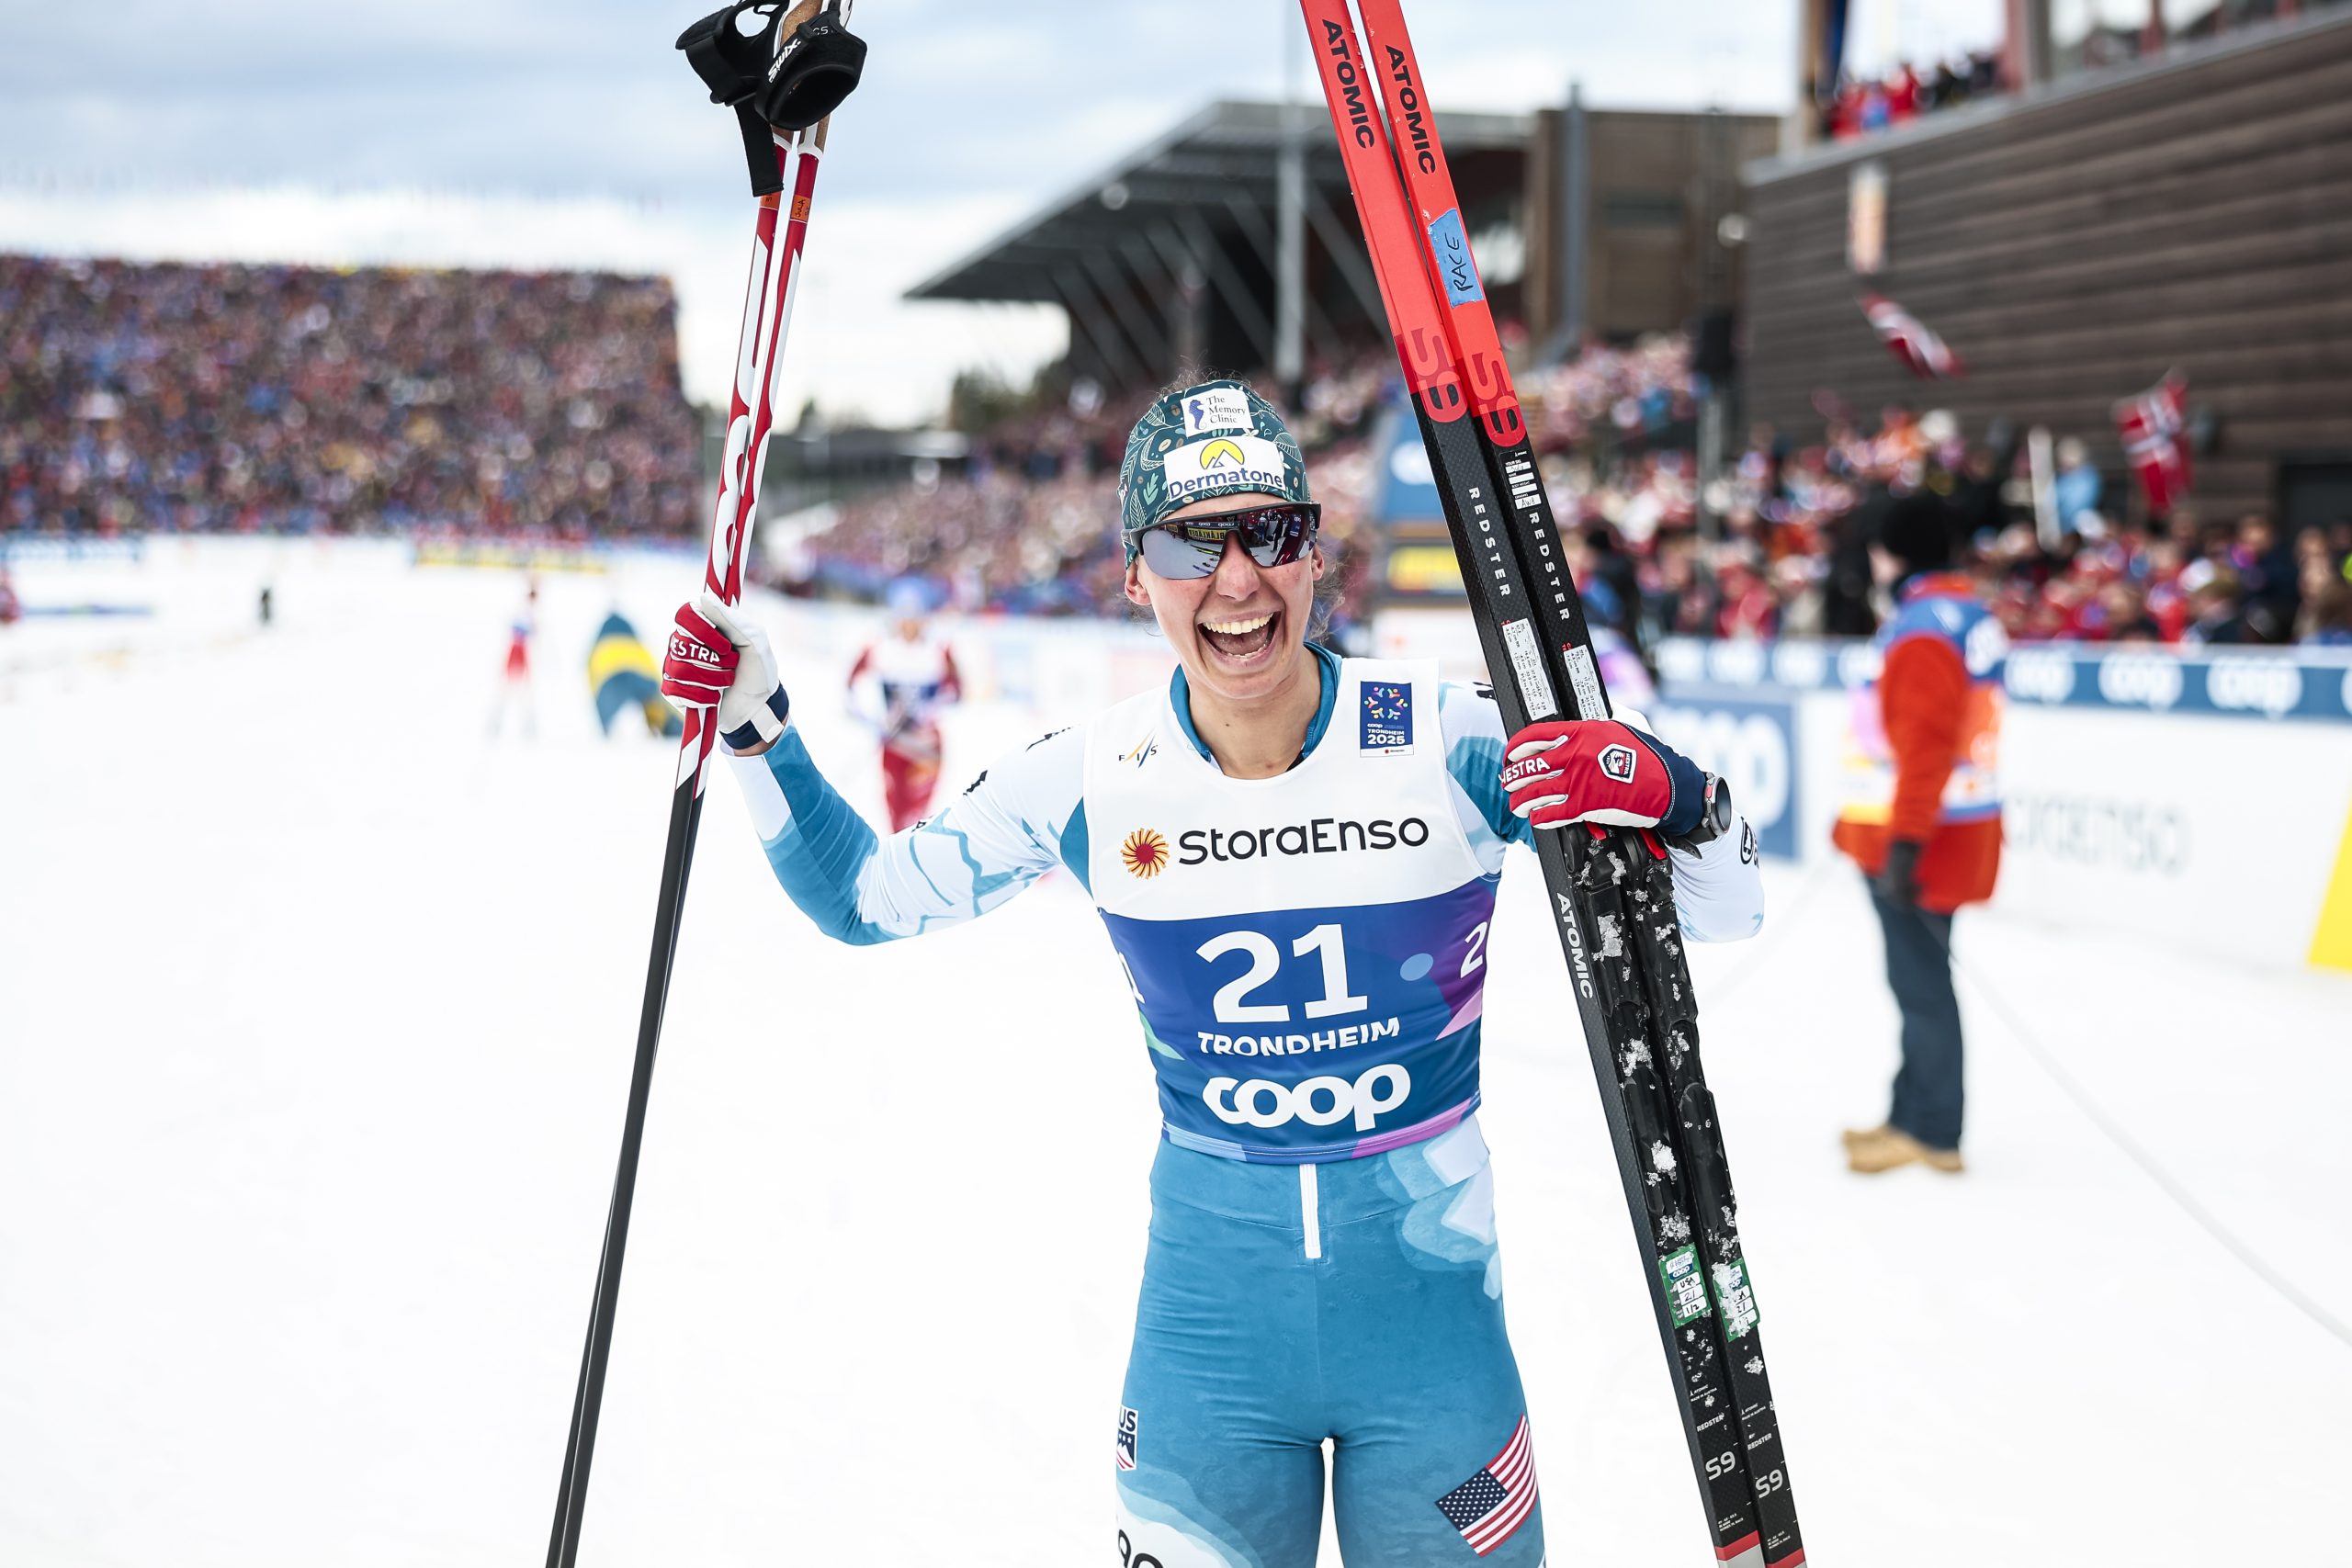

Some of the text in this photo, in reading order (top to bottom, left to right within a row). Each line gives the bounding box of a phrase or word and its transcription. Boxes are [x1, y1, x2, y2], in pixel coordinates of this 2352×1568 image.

[1322, 18, 1375, 149] ATOMIC
[1385, 44, 1436, 175] ATOMIC
[1444, 232, 1474, 292] RACE
[1206, 395, 1225, 405] The
[1208, 405, 1246, 417] Memory
[1210, 414, 1238, 424] Clinic
[1169, 468, 1283, 500] Dermatone
[1469, 487, 1510, 596] REDSTER
[1529, 512, 1570, 620] REDSTER
[1367, 734, 1406, 745] 2025
[1178, 817, 1430, 865] StoraEnso
[1556, 892, 1593, 999] ATOMIC
[1195, 923, 1368, 1023] 21
[1197, 1017, 1400, 1057] TRONDHEIM
[1202, 1063, 1411, 1132] coop
[1684, 1290, 1695, 1303] 21
[1686, 1304, 1699, 1314] 1/2
[1696, 1414, 1724, 1432] REDSTER
[1747, 1433, 1772, 1450] REDSTER
[1705, 1450, 1736, 1481] S9
[1755, 1469, 1783, 1499] S9
